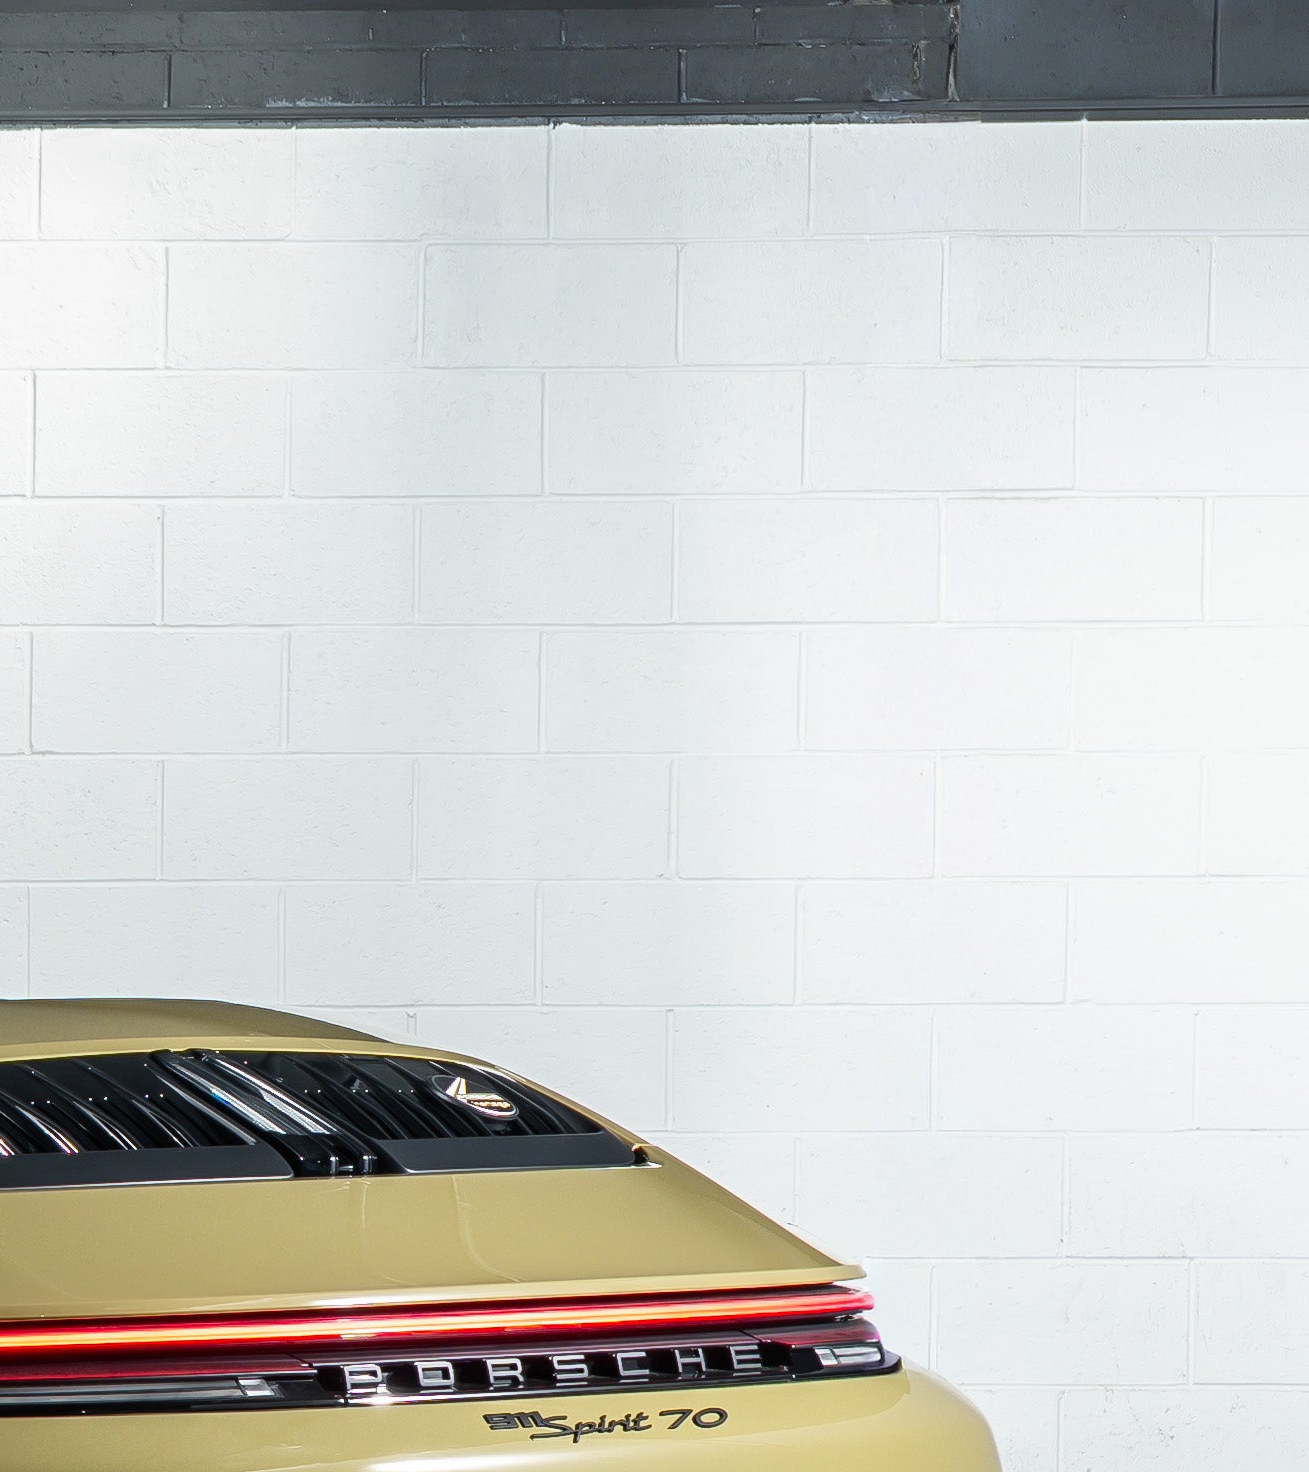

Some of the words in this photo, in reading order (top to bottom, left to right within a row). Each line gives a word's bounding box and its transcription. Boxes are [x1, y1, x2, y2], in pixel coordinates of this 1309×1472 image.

[343, 1345, 762, 1392] PORSCHE
[529, 1413, 653, 1443] Spirit
[659, 1407, 728, 1430] 70
